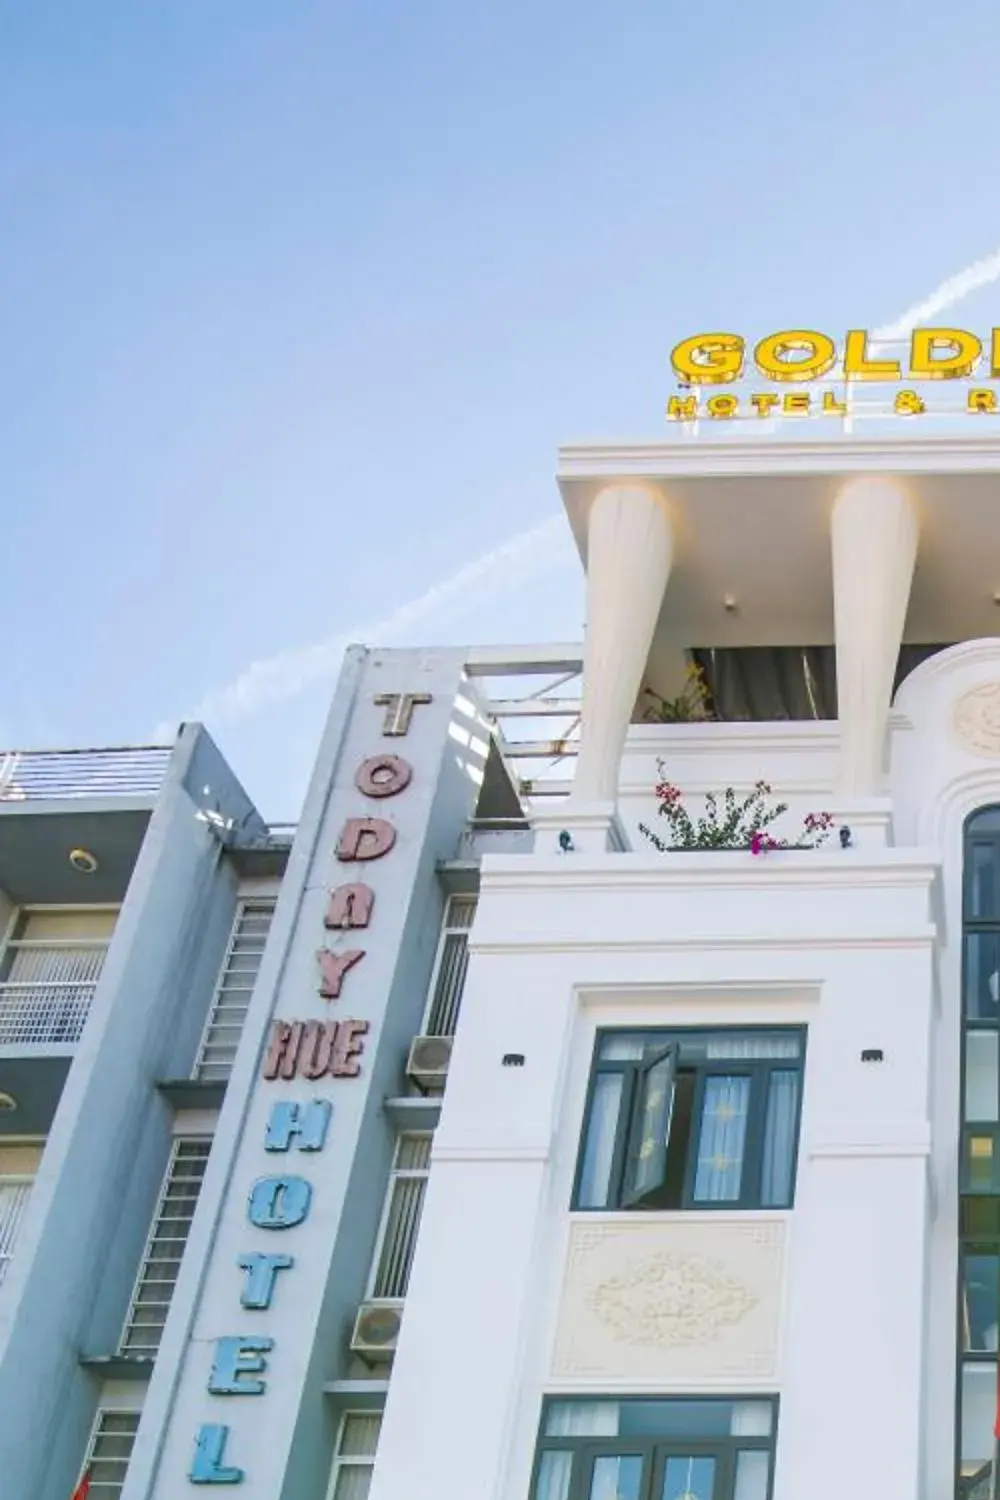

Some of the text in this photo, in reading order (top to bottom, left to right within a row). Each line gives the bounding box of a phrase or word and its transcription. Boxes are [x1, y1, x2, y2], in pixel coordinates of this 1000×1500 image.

[666, 391, 848, 421] HOTEL
[895, 390, 927, 416] &
[189, 692, 432, 1484] TODAY HUE HOTEL
